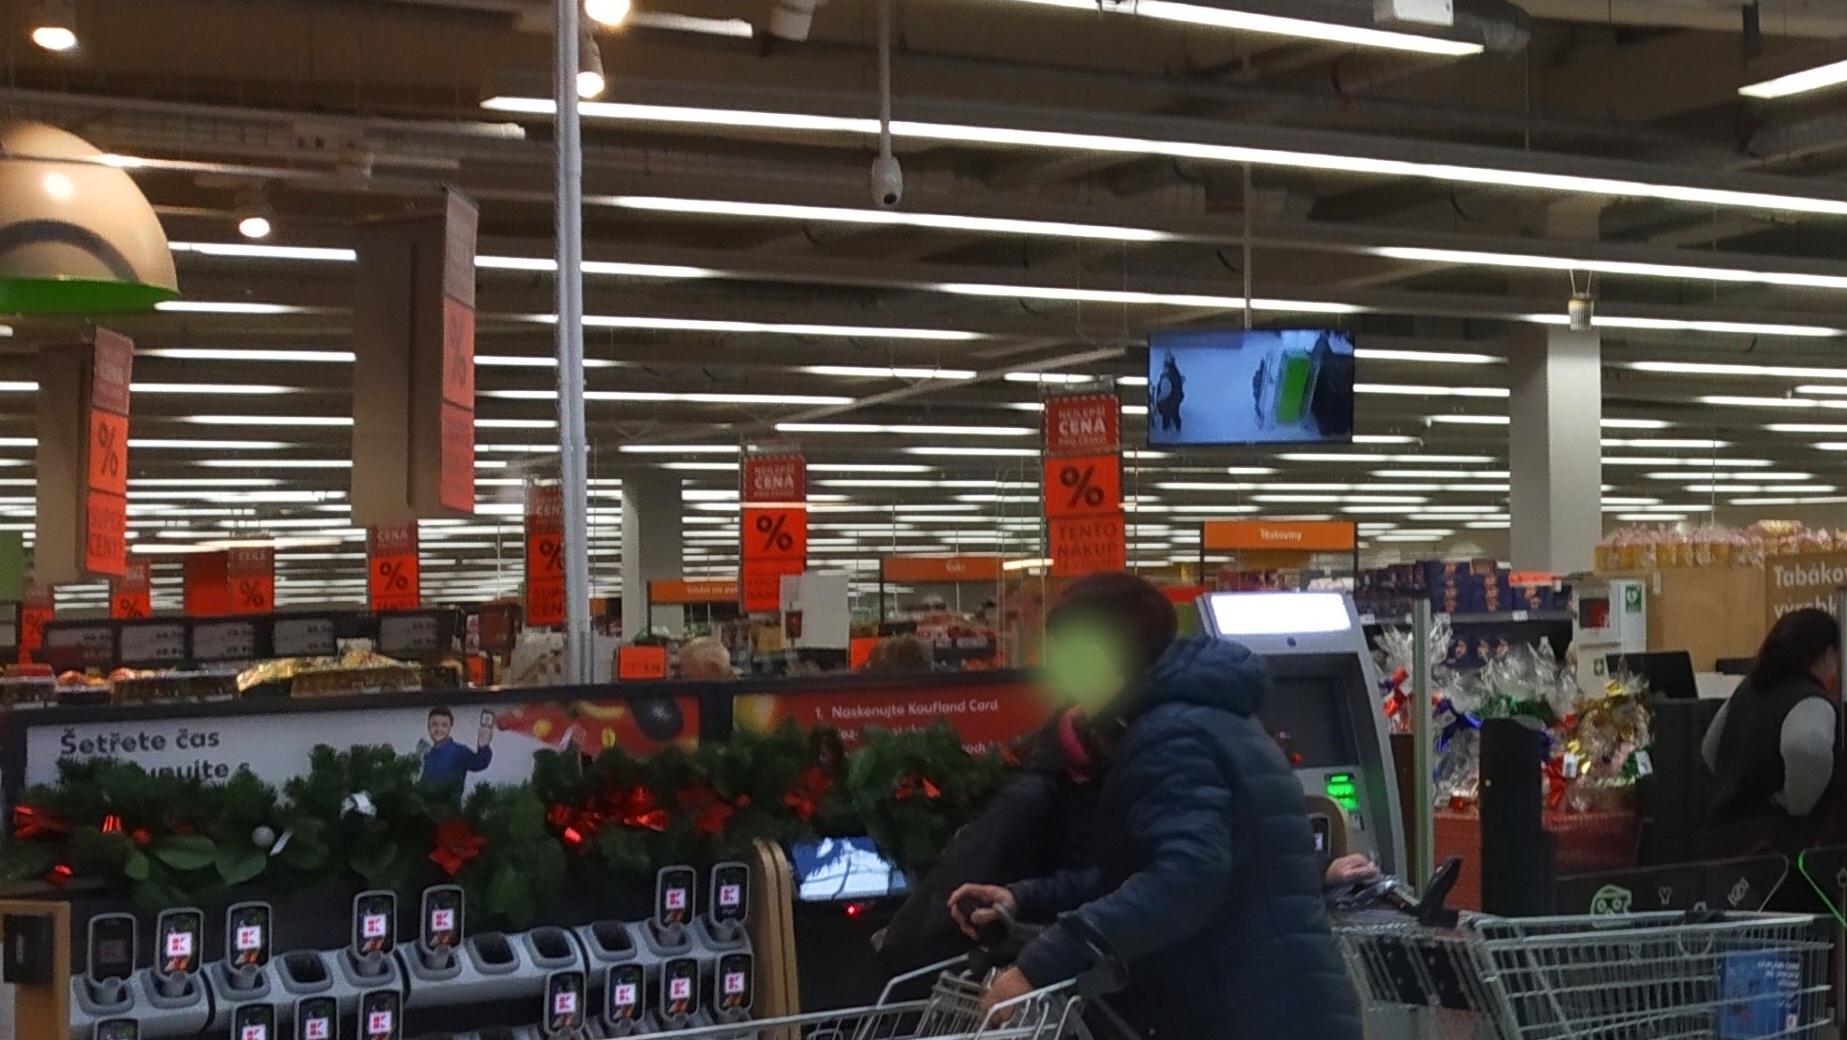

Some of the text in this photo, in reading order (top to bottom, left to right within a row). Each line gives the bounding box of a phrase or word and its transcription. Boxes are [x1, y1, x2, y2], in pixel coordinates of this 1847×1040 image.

[1058, 417, 1106, 436] CENA
[754, 474, 794, 490] CENA
[1059, 464, 1105, 508] %
[756, 513, 793, 550] %
[832, 704, 905, 719] Naskenujte
[908, 700, 967, 716] Kaufland
[969, 698, 999, 712] Card
[60, 727, 220, 755] Šetřete čas
